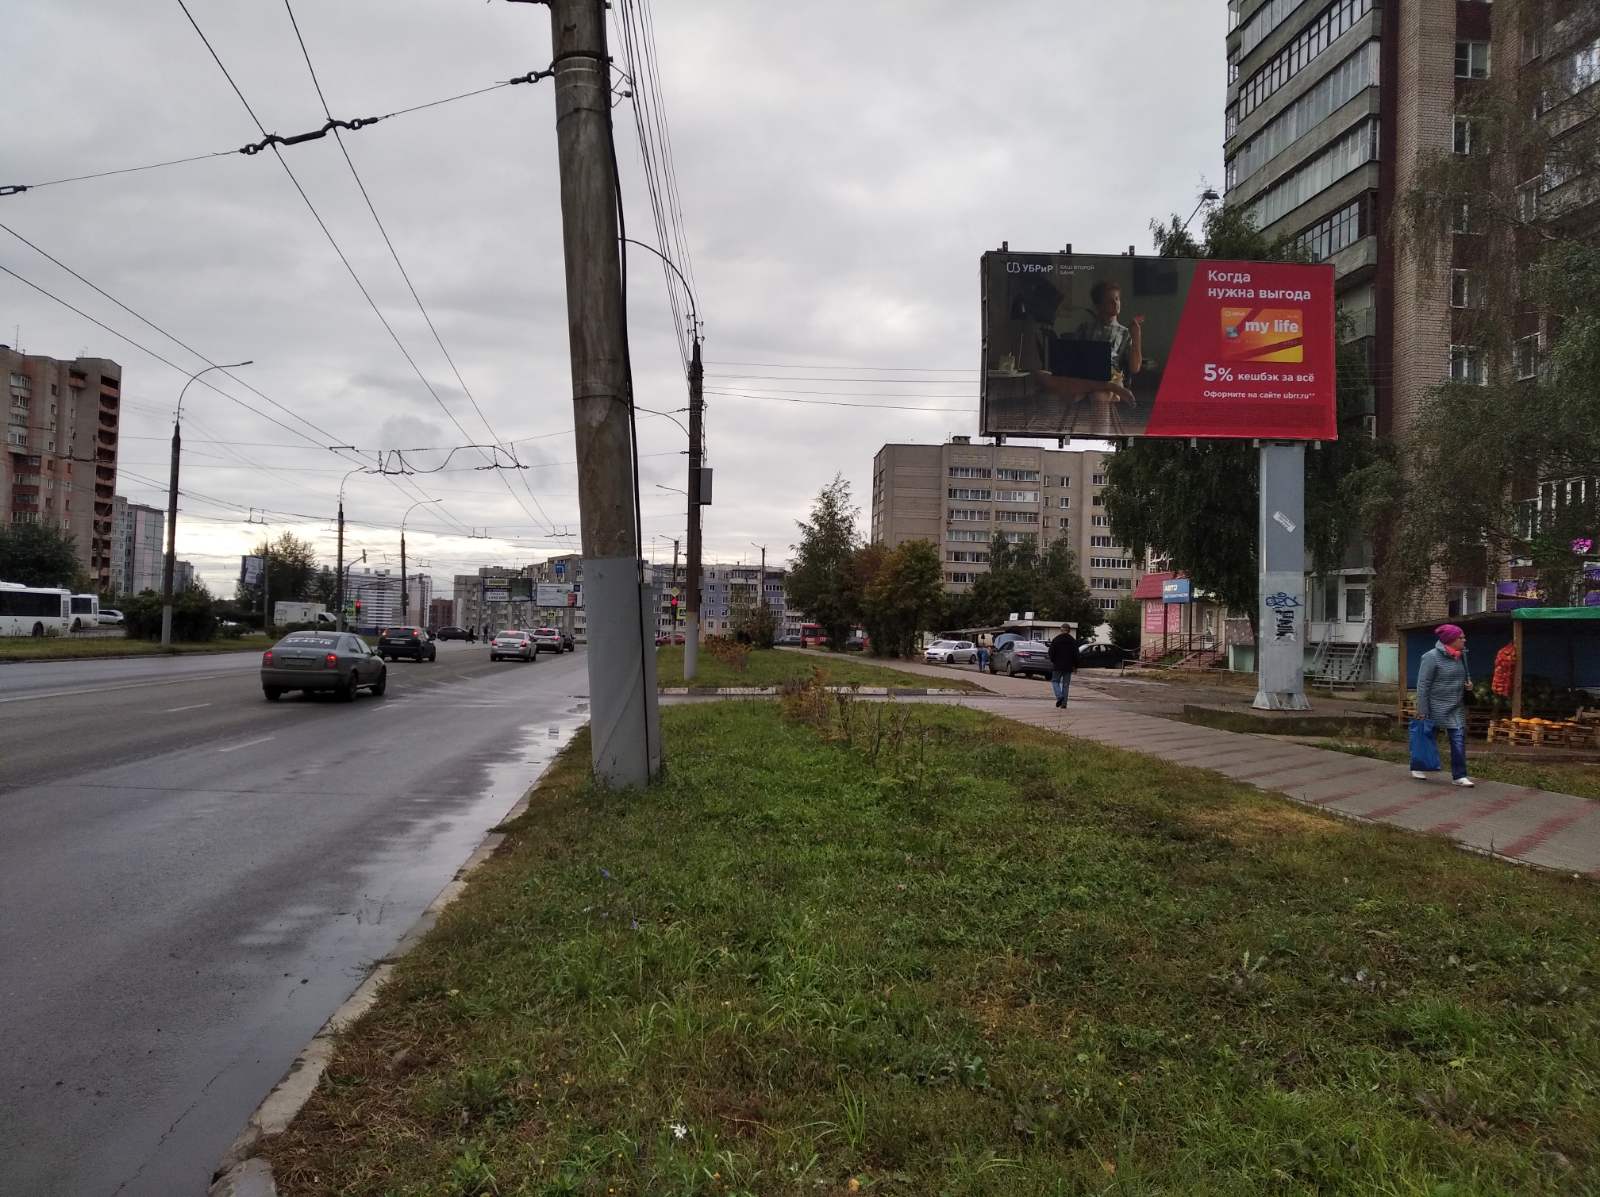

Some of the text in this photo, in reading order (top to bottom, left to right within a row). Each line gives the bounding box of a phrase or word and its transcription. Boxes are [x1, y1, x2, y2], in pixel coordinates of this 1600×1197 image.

[1022, 264, 1054, 273] УБРиР
[1208, 270, 1251, 284] Когда
[1208, 287, 1311, 301] нужна выгода
[1245, 319, 1299, 334] my life
[1203, 363, 1315, 382] 5% кешбэк за всё
[1203, 390, 1246, 399] Оформите
[1259, 391, 1282, 399] сайте
